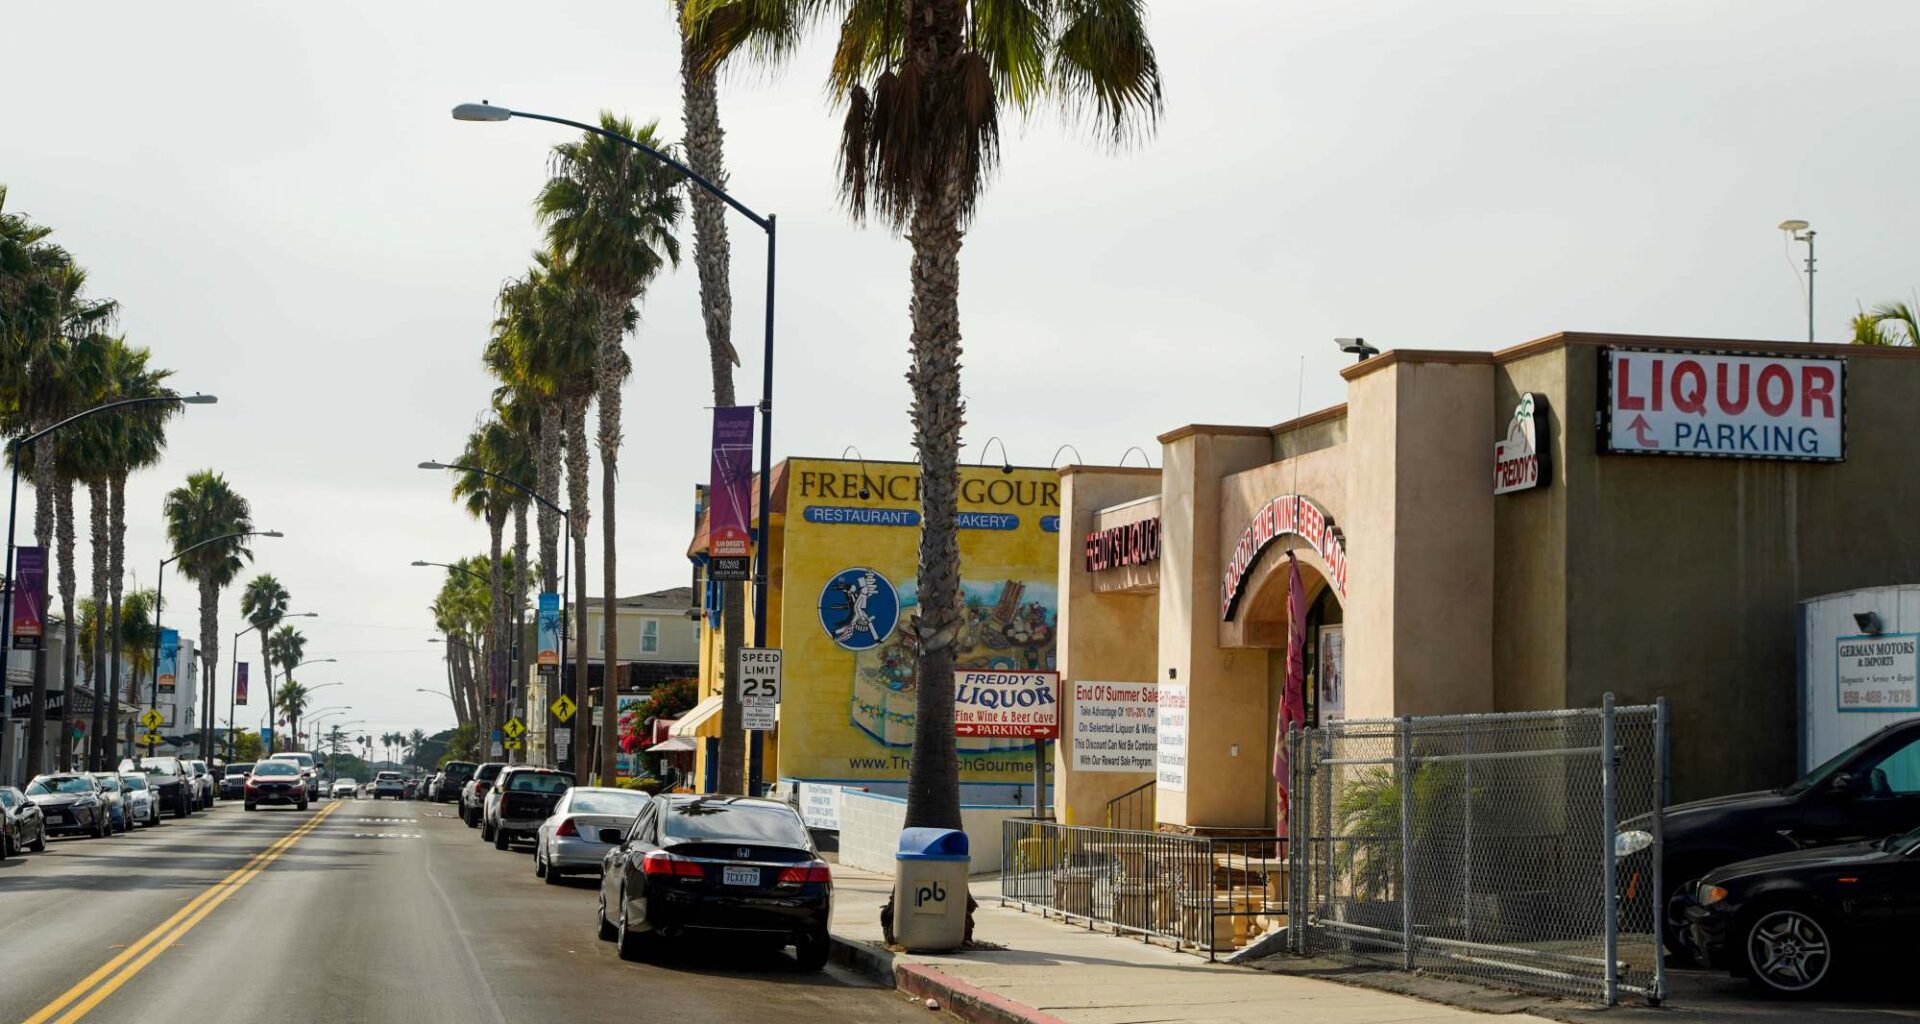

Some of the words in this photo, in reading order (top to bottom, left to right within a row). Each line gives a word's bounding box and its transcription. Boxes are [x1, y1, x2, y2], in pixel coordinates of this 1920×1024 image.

[1617, 358, 1835, 418] LIQUOR
[1674, 422, 1819, 454] PARKING
[1495, 445, 1538, 489] FREDDY'S
[813, 508, 910, 524] RESTAURANT
[1086, 527, 1120, 572] FREDDY'S
[1222, 528, 1254, 619] LIQUOR
[1252, 502, 1274, 556] FINE
[1273, 496, 1298, 535] WINE
[1299, 497, 1324, 557] BEER
[1840, 644, 1874, 657] GERMAN
[1877, 642, 1914, 655] MOTORS
[741, 653, 780, 663] SPEED
[1864, 656, 1895, 667] IMPORTS
[744, 665, 776, 675] LIMIT
[742, 678, 777, 697] 25
[964, 674, 1045, 686] FREDDY'S
[955, 684, 1055, 709] LIQUOR
[1076, 685, 1093, 701] End
[1094, 685, 1105, 701] Of
[1106, 686, 1140, 702] Summer
[1142, 687, 1159, 703] Sale
[955, 710, 974, 722] Fine
[977, 710, 998, 723] Wine
[1001, 711, 1007, 723] &
[1011, 711, 1031, 723] Beer
[1034, 712, 1054, 723] Cave
[1080, 705, 1092, 717] Take
[1092, 706, 1117, 720] Advantage
[1118, 707, 1124, 717] Of
[977, 725, 1031, 736] PARKING
[1079, 722, 1088, 733] On
[1089, 722, 1114, 733] Selected
[1115, 723, 1135, 735] Liquor
[1136, 723, 1140, 733] &
[1142, 723, 1156, 734] Wine
[1075, 738, 1085, 749] This
[1085, 738, 1107, 750] Discount
[1108, 739, 1118, 750] Can
[1118, 739, 1127, 750] Not
[1127, 739, 1134, 750] Be
[1080, 755, 1091, 766] With
[1092, 755, 1101, 766] Our
[1102, 755, 1120, 767] Reward
[1120, 755, 1131, 767] Sale
[1131, 756, 1153, 769] Program.
[725, 872, 758, 883] 7CXX779
[918, 881, 946, 907] pb
